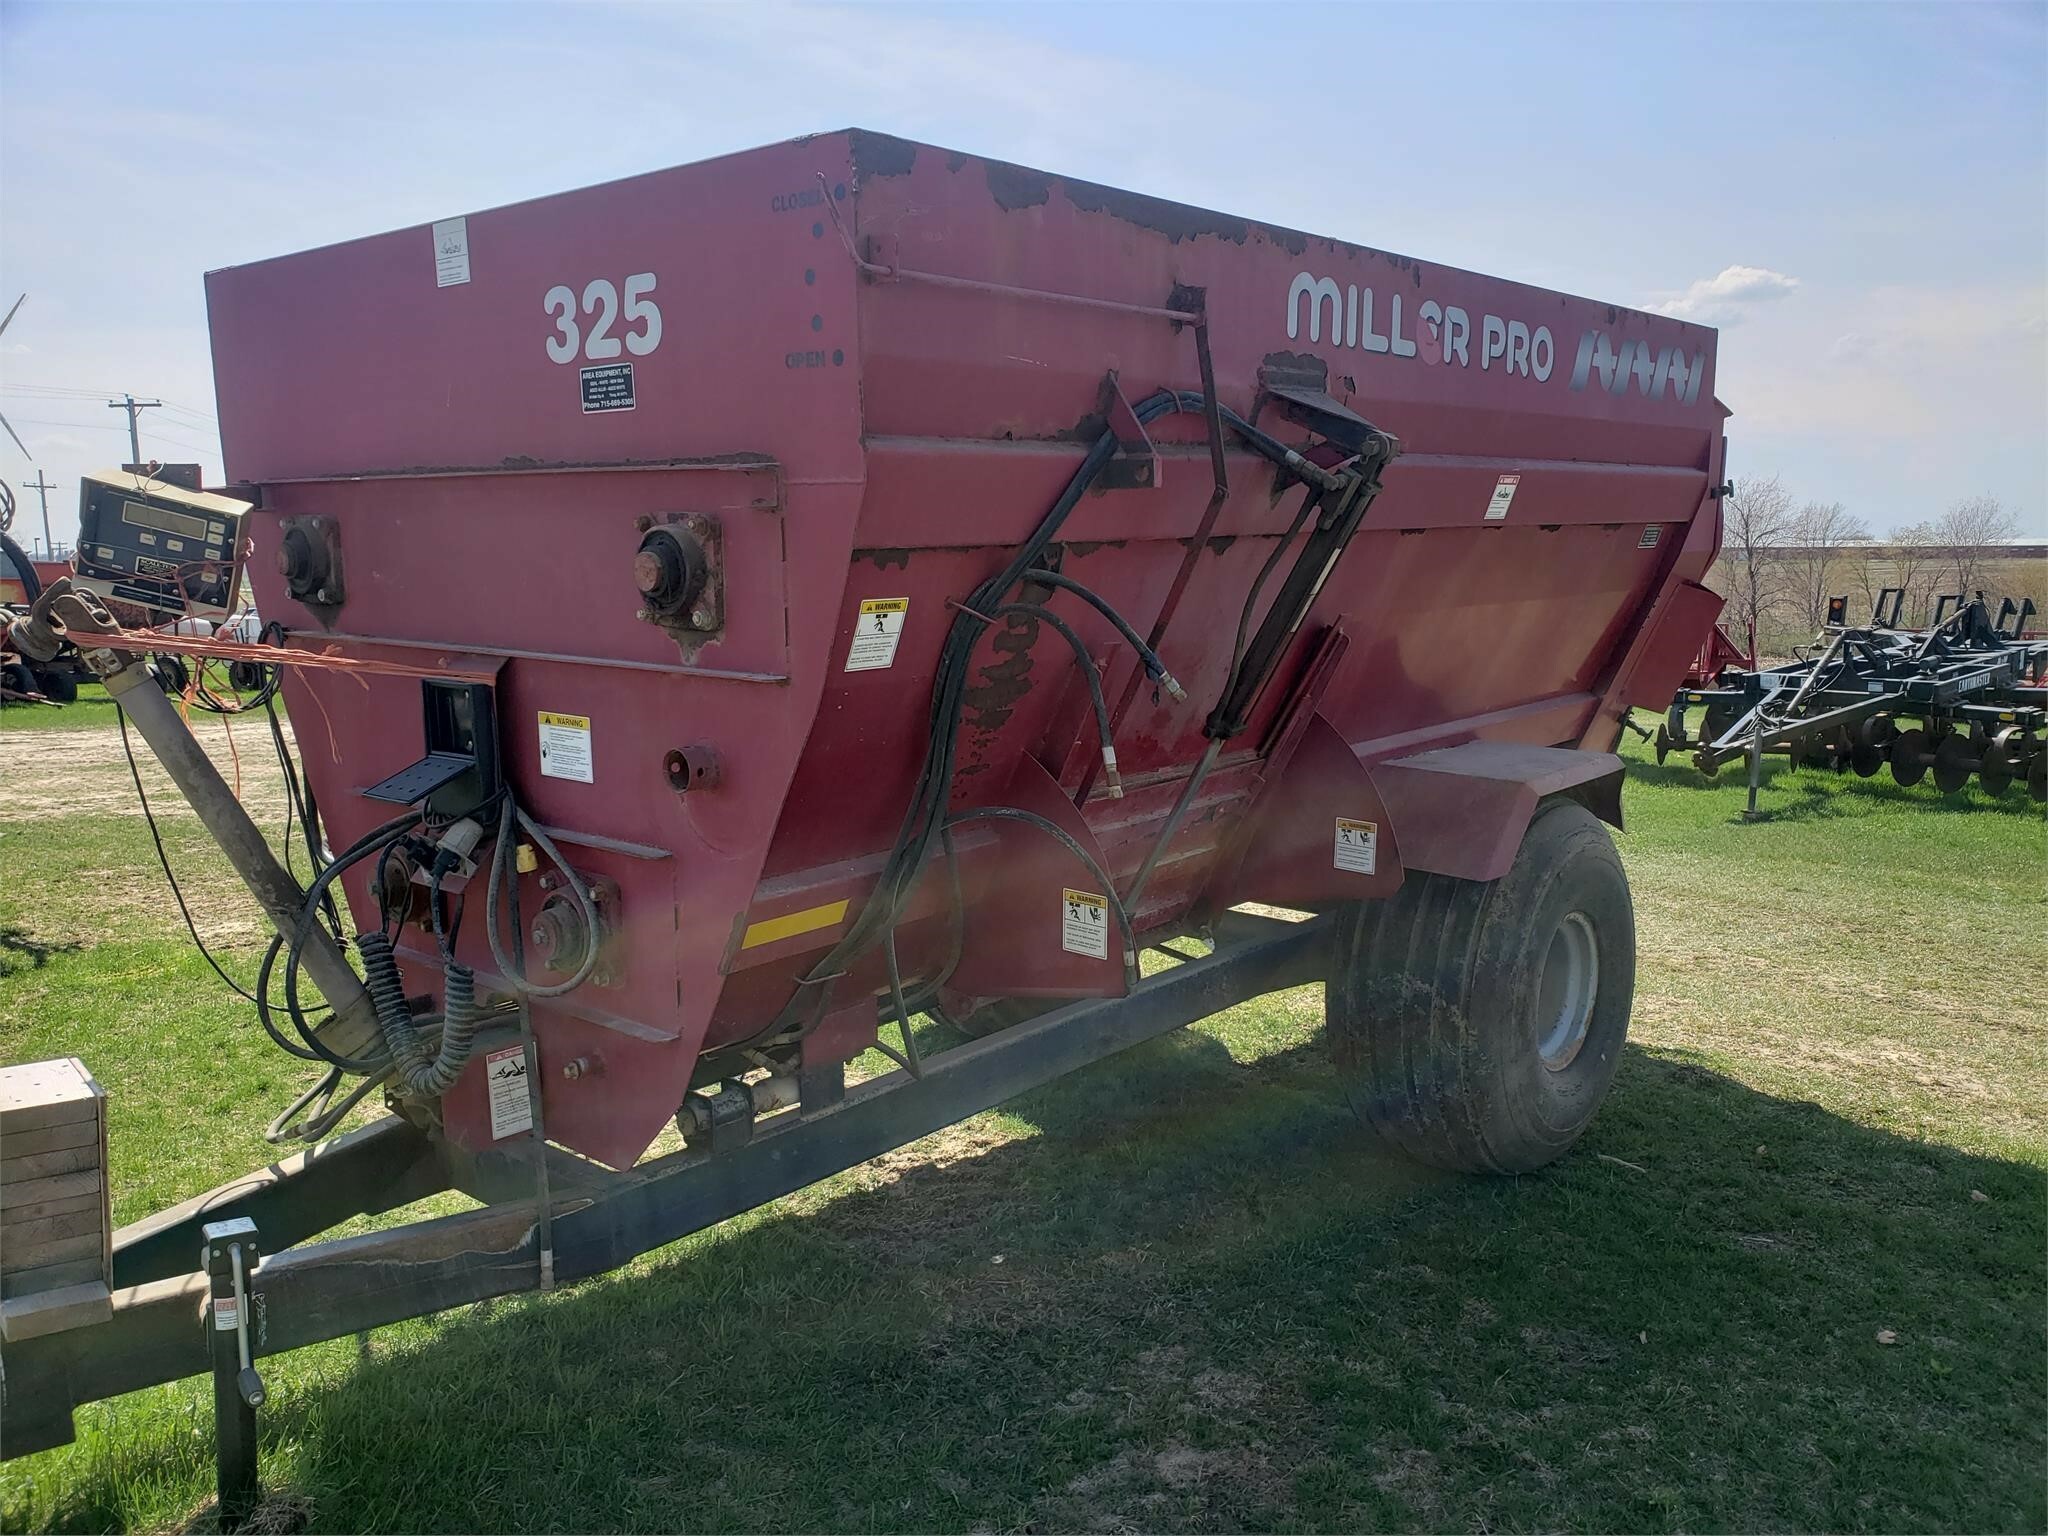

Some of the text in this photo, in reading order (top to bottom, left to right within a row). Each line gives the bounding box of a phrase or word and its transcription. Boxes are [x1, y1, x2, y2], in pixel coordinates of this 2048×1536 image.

[543, 272, 663, 364] 325
[1480, 313, 1554, 382] PRO
[785, 350, 826, 370] OPEN
[874, 601, 902, 611] WARNING
[557, 716, 583, 727] WARNING
[1076, 894, 1102, 906] WARNING
